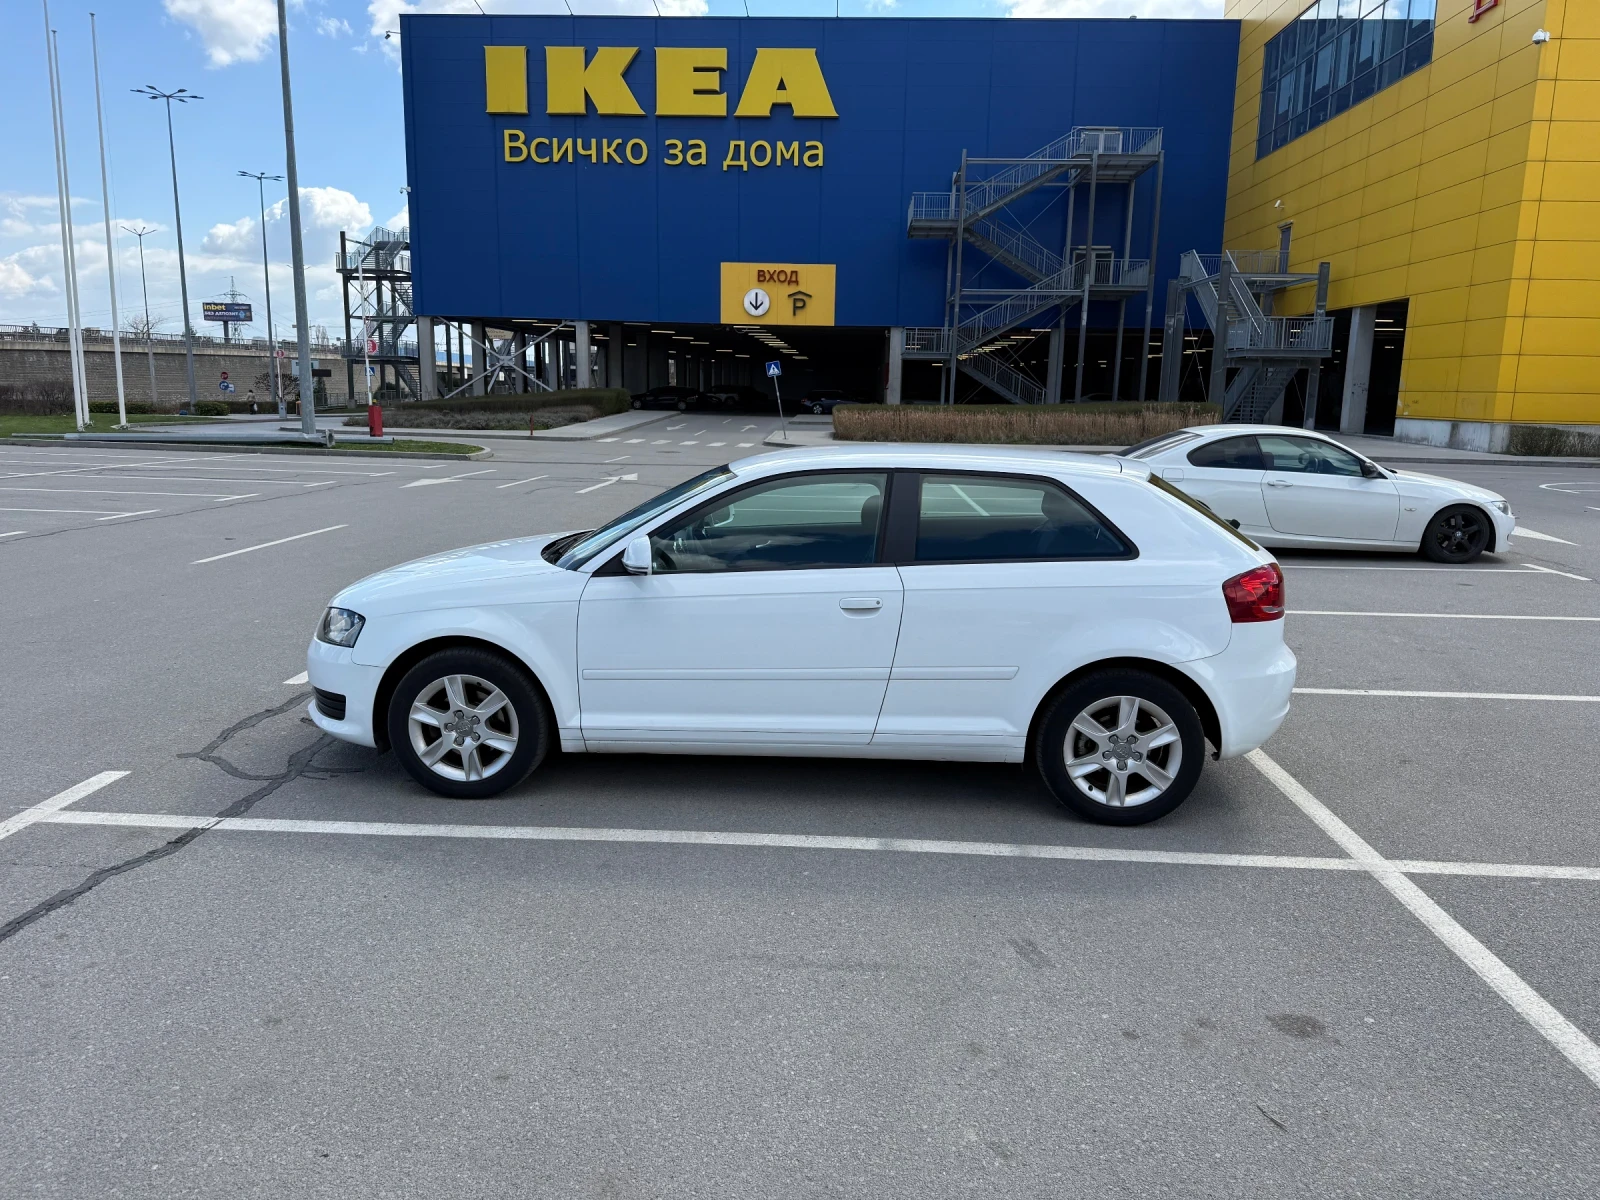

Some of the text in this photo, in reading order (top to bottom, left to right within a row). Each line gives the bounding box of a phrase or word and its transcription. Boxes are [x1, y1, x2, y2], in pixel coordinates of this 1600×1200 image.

[483, 45, 839, 118] IKEA
[503, 129, 825, 172] Всичко за дома
[757, 269, 799, 286] ВХОД
[203, 303, 226, 311] inbet
